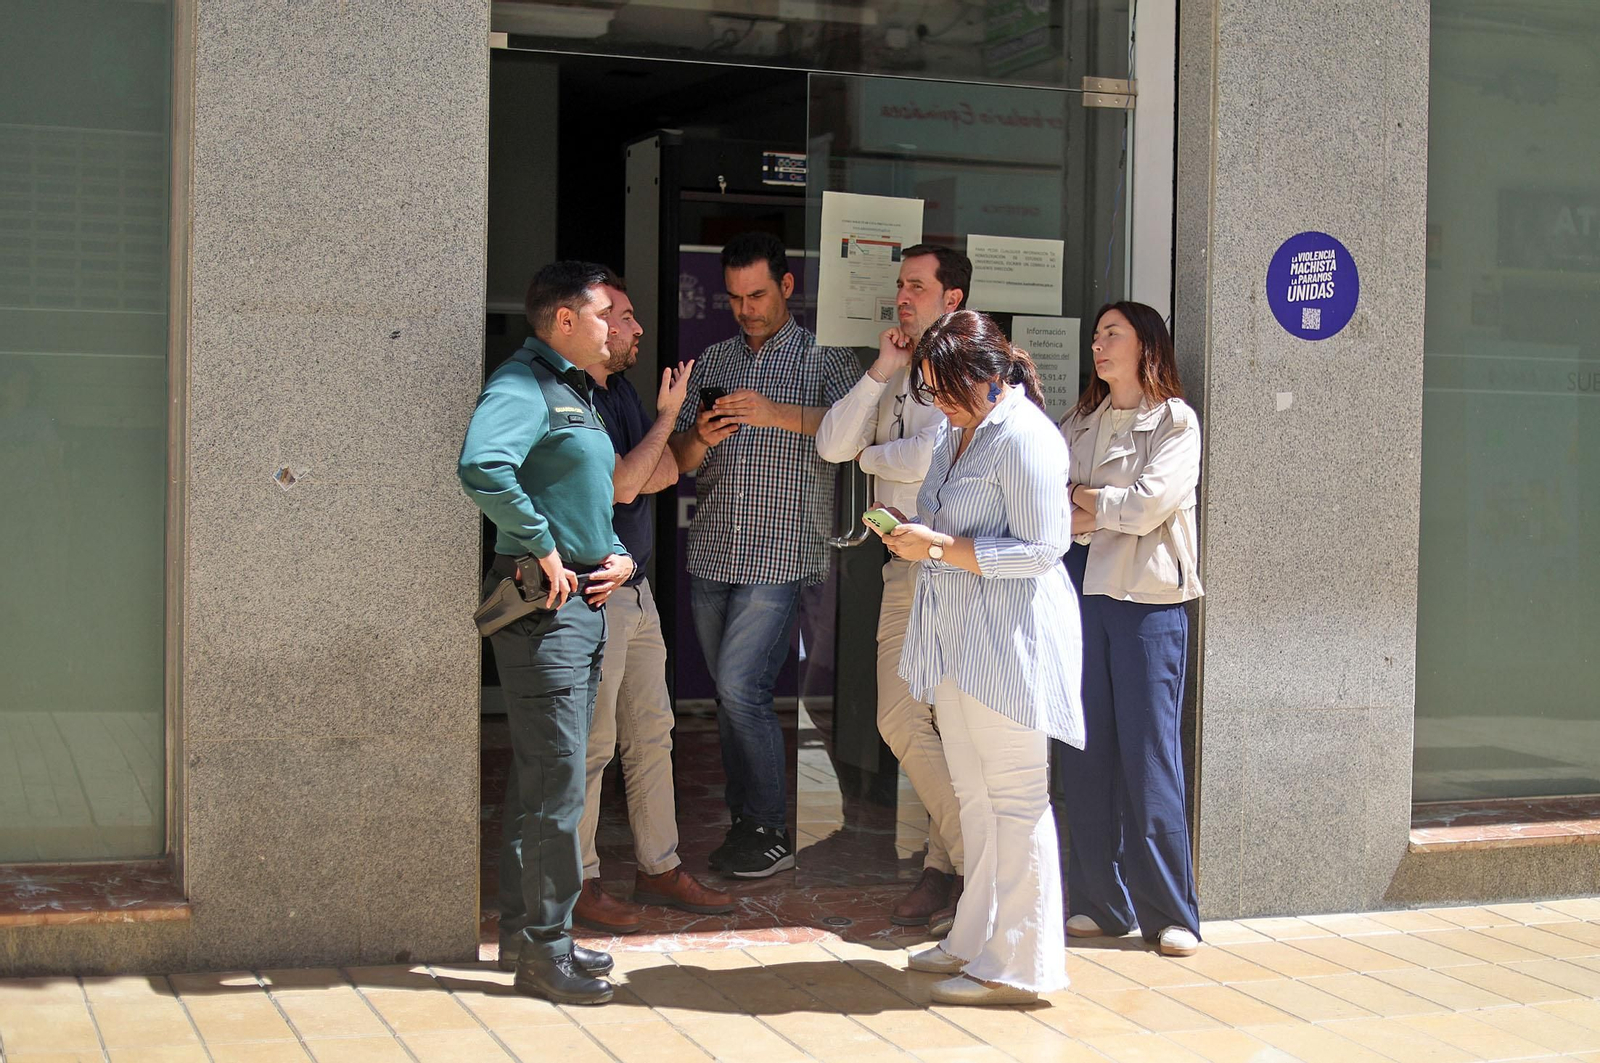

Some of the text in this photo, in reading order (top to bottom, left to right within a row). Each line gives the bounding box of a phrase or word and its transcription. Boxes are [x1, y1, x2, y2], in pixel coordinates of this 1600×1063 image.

[1298, 249, 1335, 262] VIOLENCIA
[1290, 260, 1336, 275] MACHISTA
[1298, 272, 1333, 284] PARAMOS
[1287, 282, 1334, 302] UNIDAS
[1026, 326, 1067, 336] Información
[1029, 340, 1063, 349] Telefónica
[1031, 352, 1060, 361] delegación
